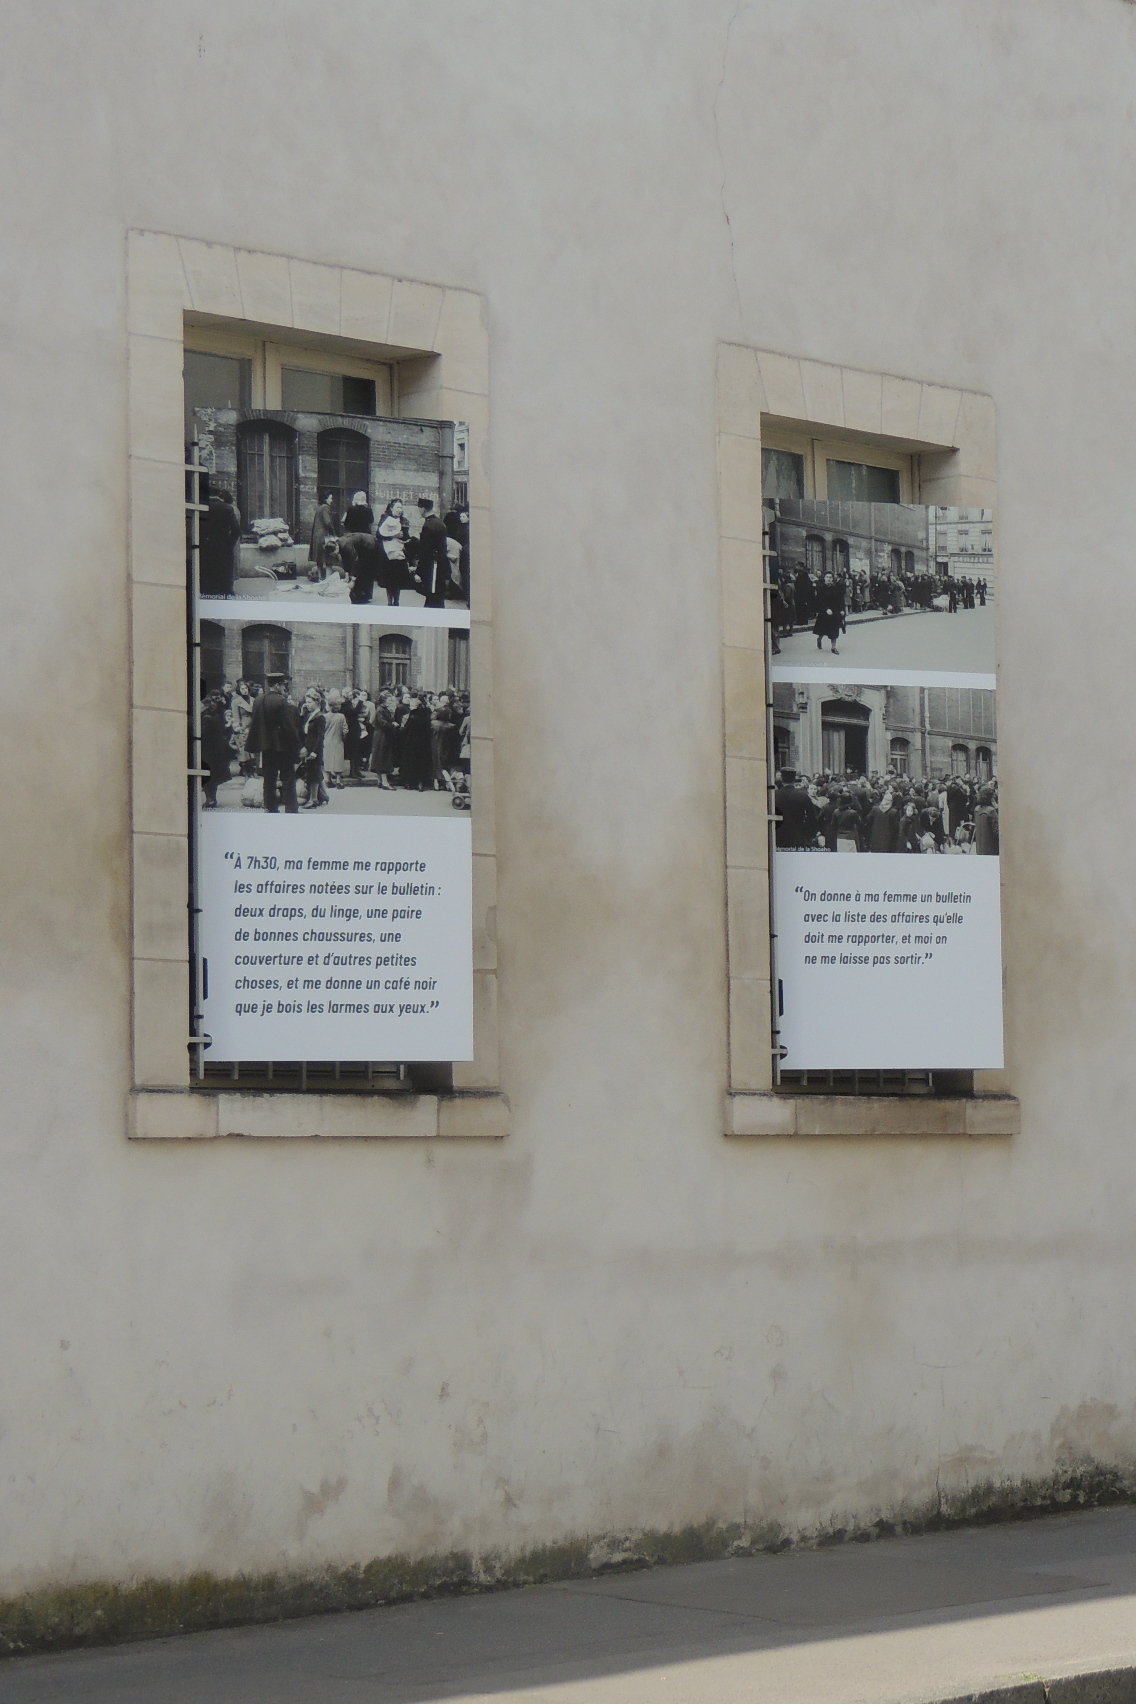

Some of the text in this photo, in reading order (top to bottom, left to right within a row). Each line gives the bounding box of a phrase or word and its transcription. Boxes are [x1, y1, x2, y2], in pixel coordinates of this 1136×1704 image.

[224, 852, 426, 875] “À 7h30, ma femme me rapporte
[234, 880, 435, 896] les affaires notées sur le bulletin
[795, 886, 972, 904] “On donne à ma femme un bulletin
[234, 904, 422, 922] deux draps, du linge, une paire
[804, 911, 963, 926] avec la liste des affaires qu’elle
[235, 928, 402, 944] de bonnes chaussures, une
[804, 932, 947, 946] doit me rapporter, et moi on
[235, 953, 417, 969] couverture et d’autres petites
[805, 953, 933, 967] ne me laisse pas sortir.”
[235, 976, 437, 991] choses, et me donne un café noir
[235, 1000, 440, 1017] que je bois les larmes aux yeux.”
